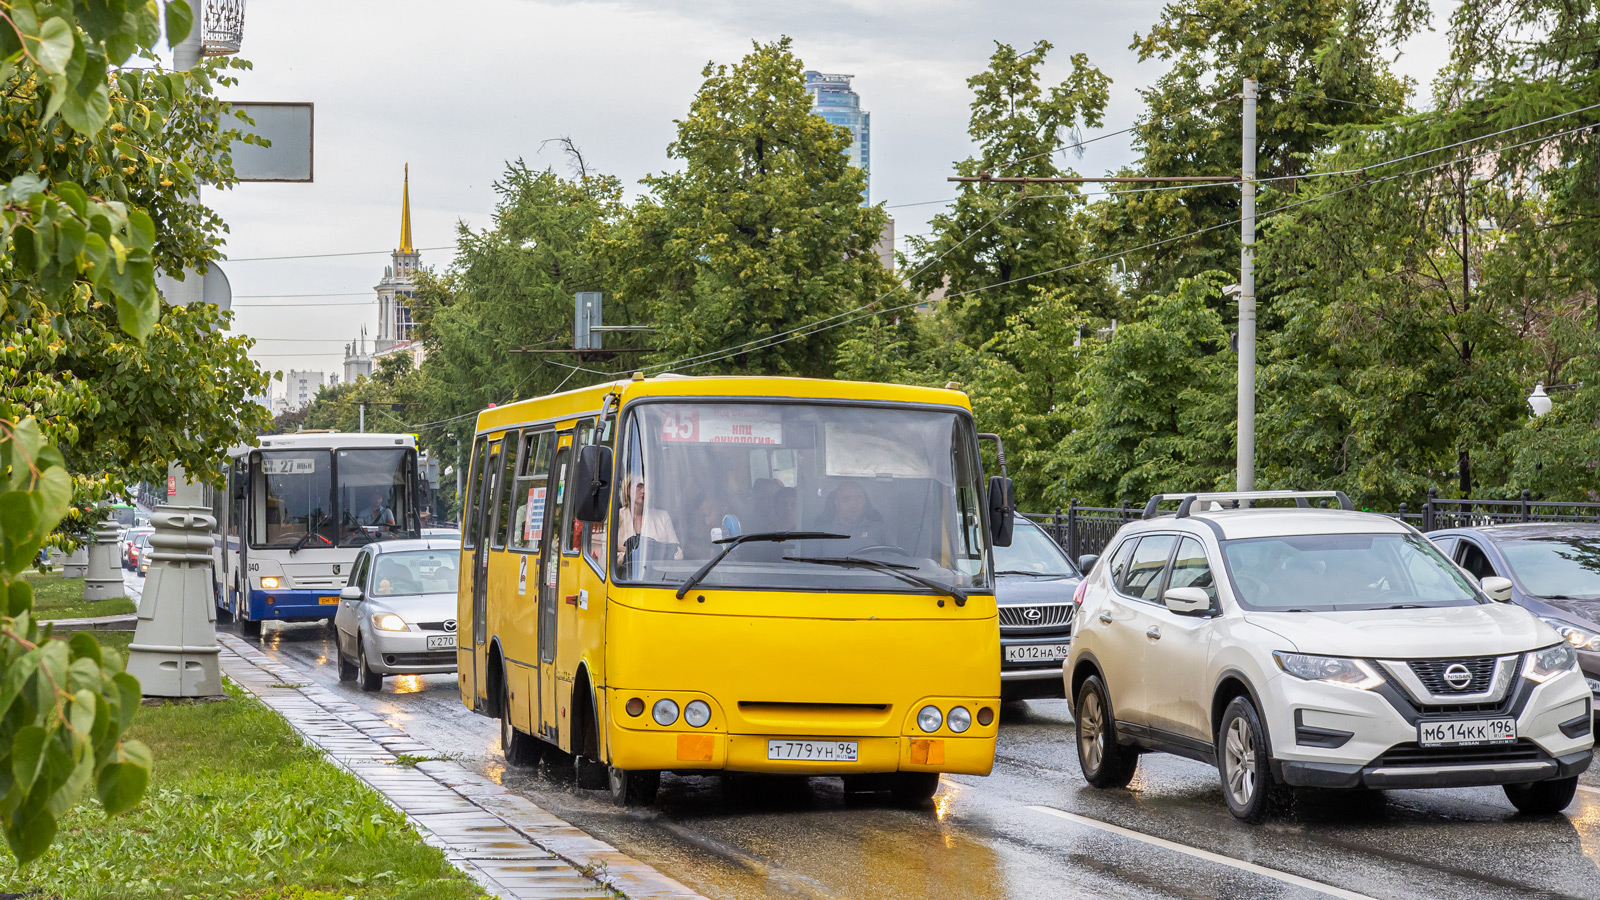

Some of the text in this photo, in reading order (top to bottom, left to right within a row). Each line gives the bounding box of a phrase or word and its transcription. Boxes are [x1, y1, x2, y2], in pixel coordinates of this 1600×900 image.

[663, 409, 694, 439] 45
[732, 424, 752, 435] НПЦ
[280, 459, 294, 473] 27
[1056, 645, 1067, 654] 96
[1489, 720, 1511, 734] 196
[838, 743, 852, 755] 96
